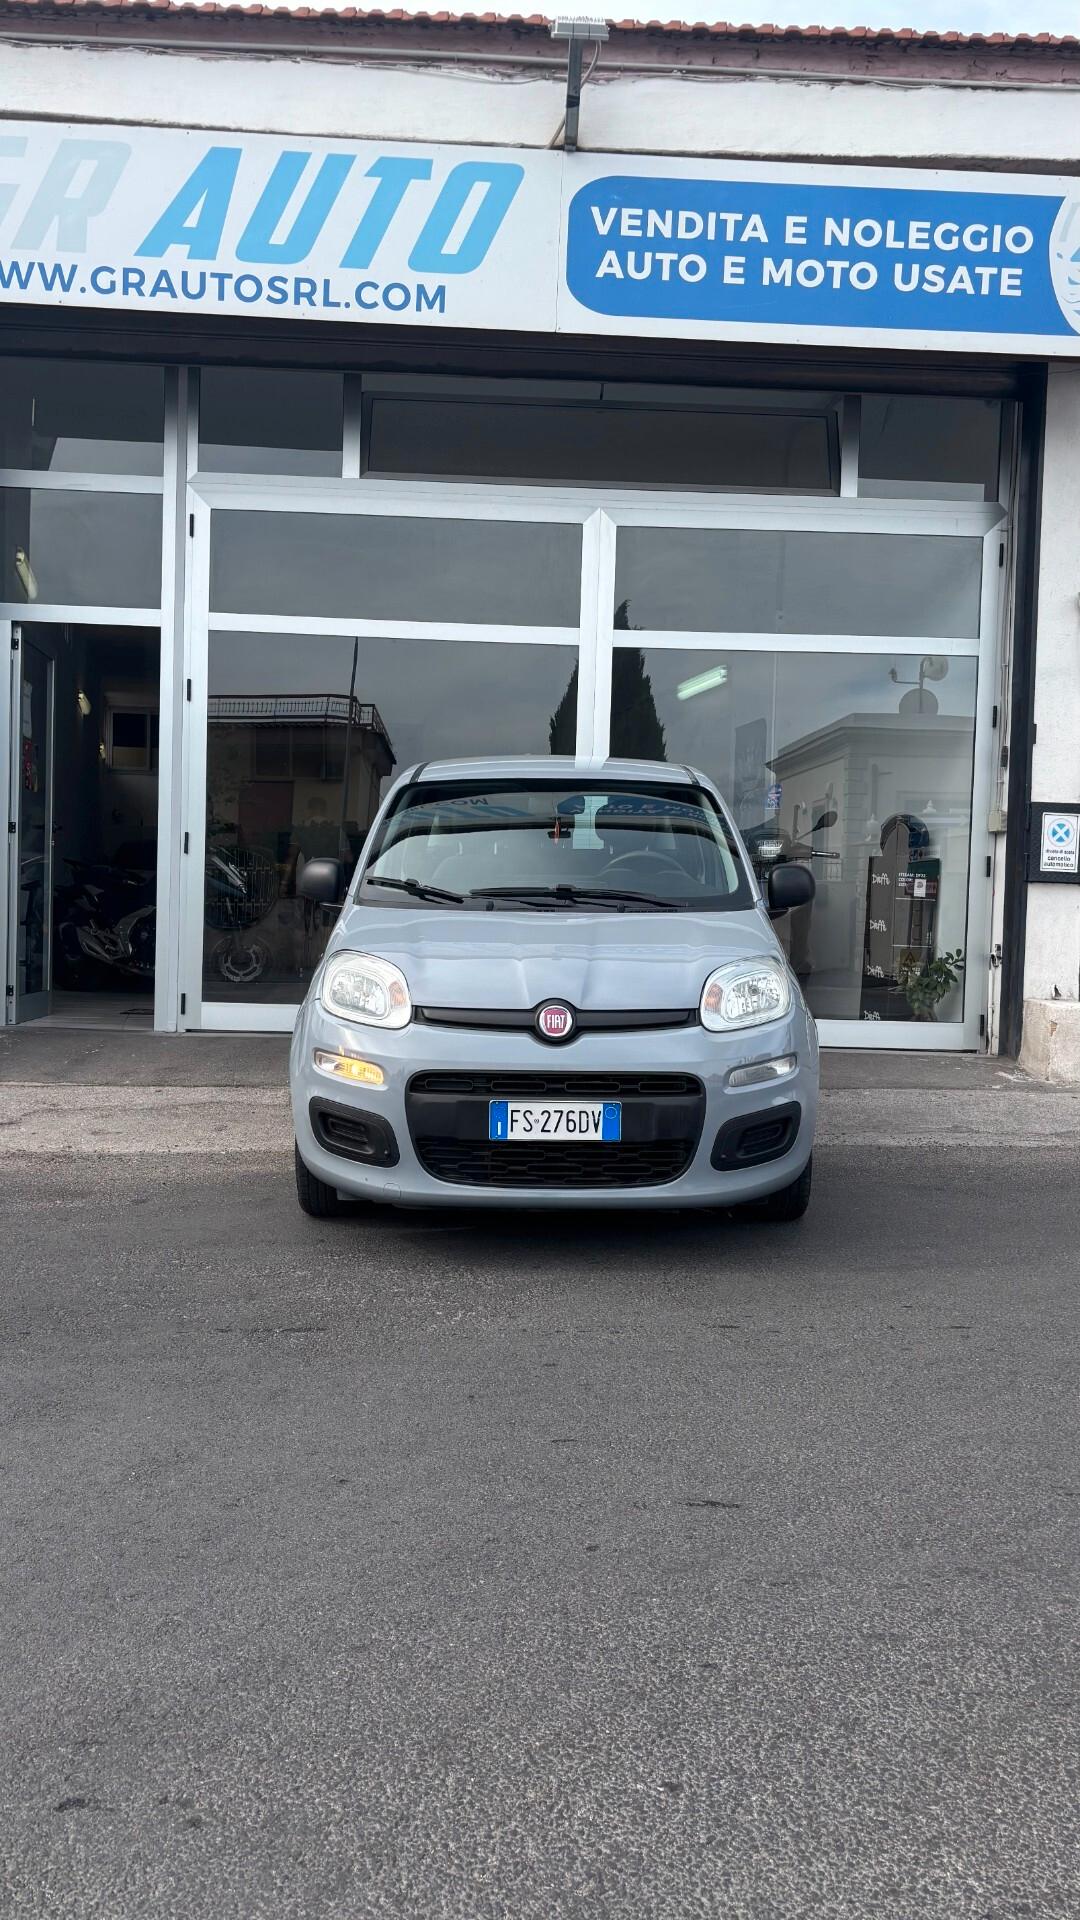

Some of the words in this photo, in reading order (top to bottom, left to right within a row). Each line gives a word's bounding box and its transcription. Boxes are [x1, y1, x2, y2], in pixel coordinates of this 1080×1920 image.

[0, 135, 133, 255] R
[134, 147, 526, 275] AUTO
[591, 206, 769, 243] VENDITA
[785, 215, 808, 245] E
[825, 217, 1034, 254] NOLEGGIO
[595, 251, 707, 283] AUTO
[723, 256, 743, 285] E
[762, 257, 878, 290] MOTO
[893, 263, 1023, 297] USATE
[547, 1014, 566, 1029] FIAT
